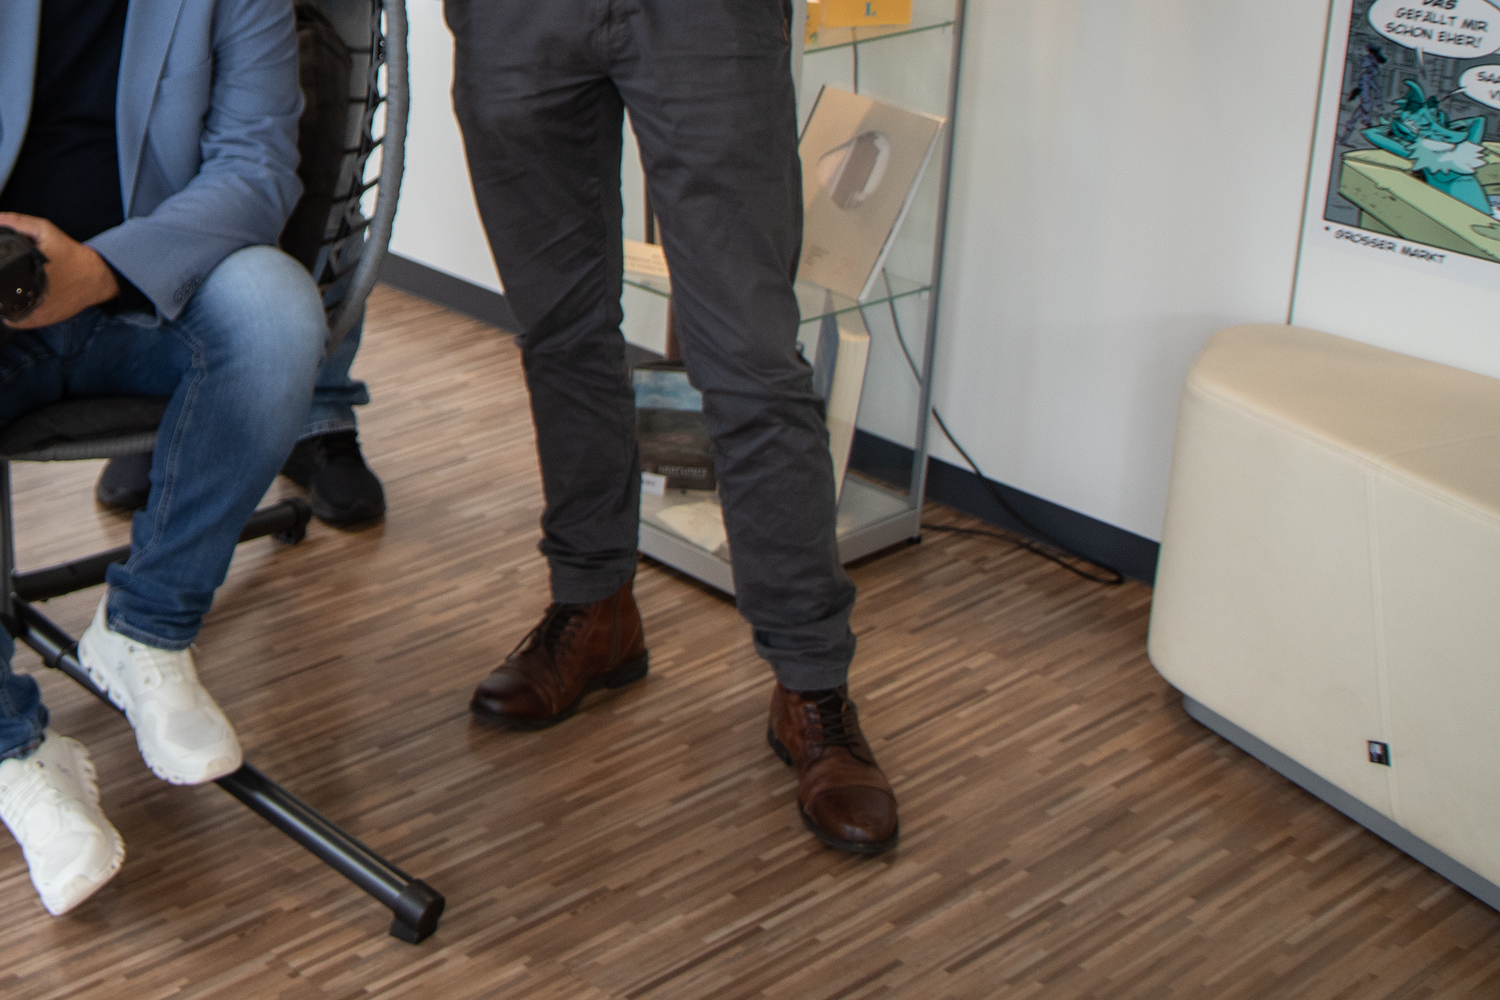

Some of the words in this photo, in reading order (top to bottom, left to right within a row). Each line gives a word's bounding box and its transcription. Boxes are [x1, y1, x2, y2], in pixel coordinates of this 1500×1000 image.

[1395, 7, 1457, 26] GEFÄLLT
[1460, 19, 1489, 32] MIR
[1385, 22, 1434, 40] SCHON
[1437, 31, 1484, 48] EHER!
[1333, 229, 1397, 252] GROSSER
[1400, 246, 1446, 264] MARKT
